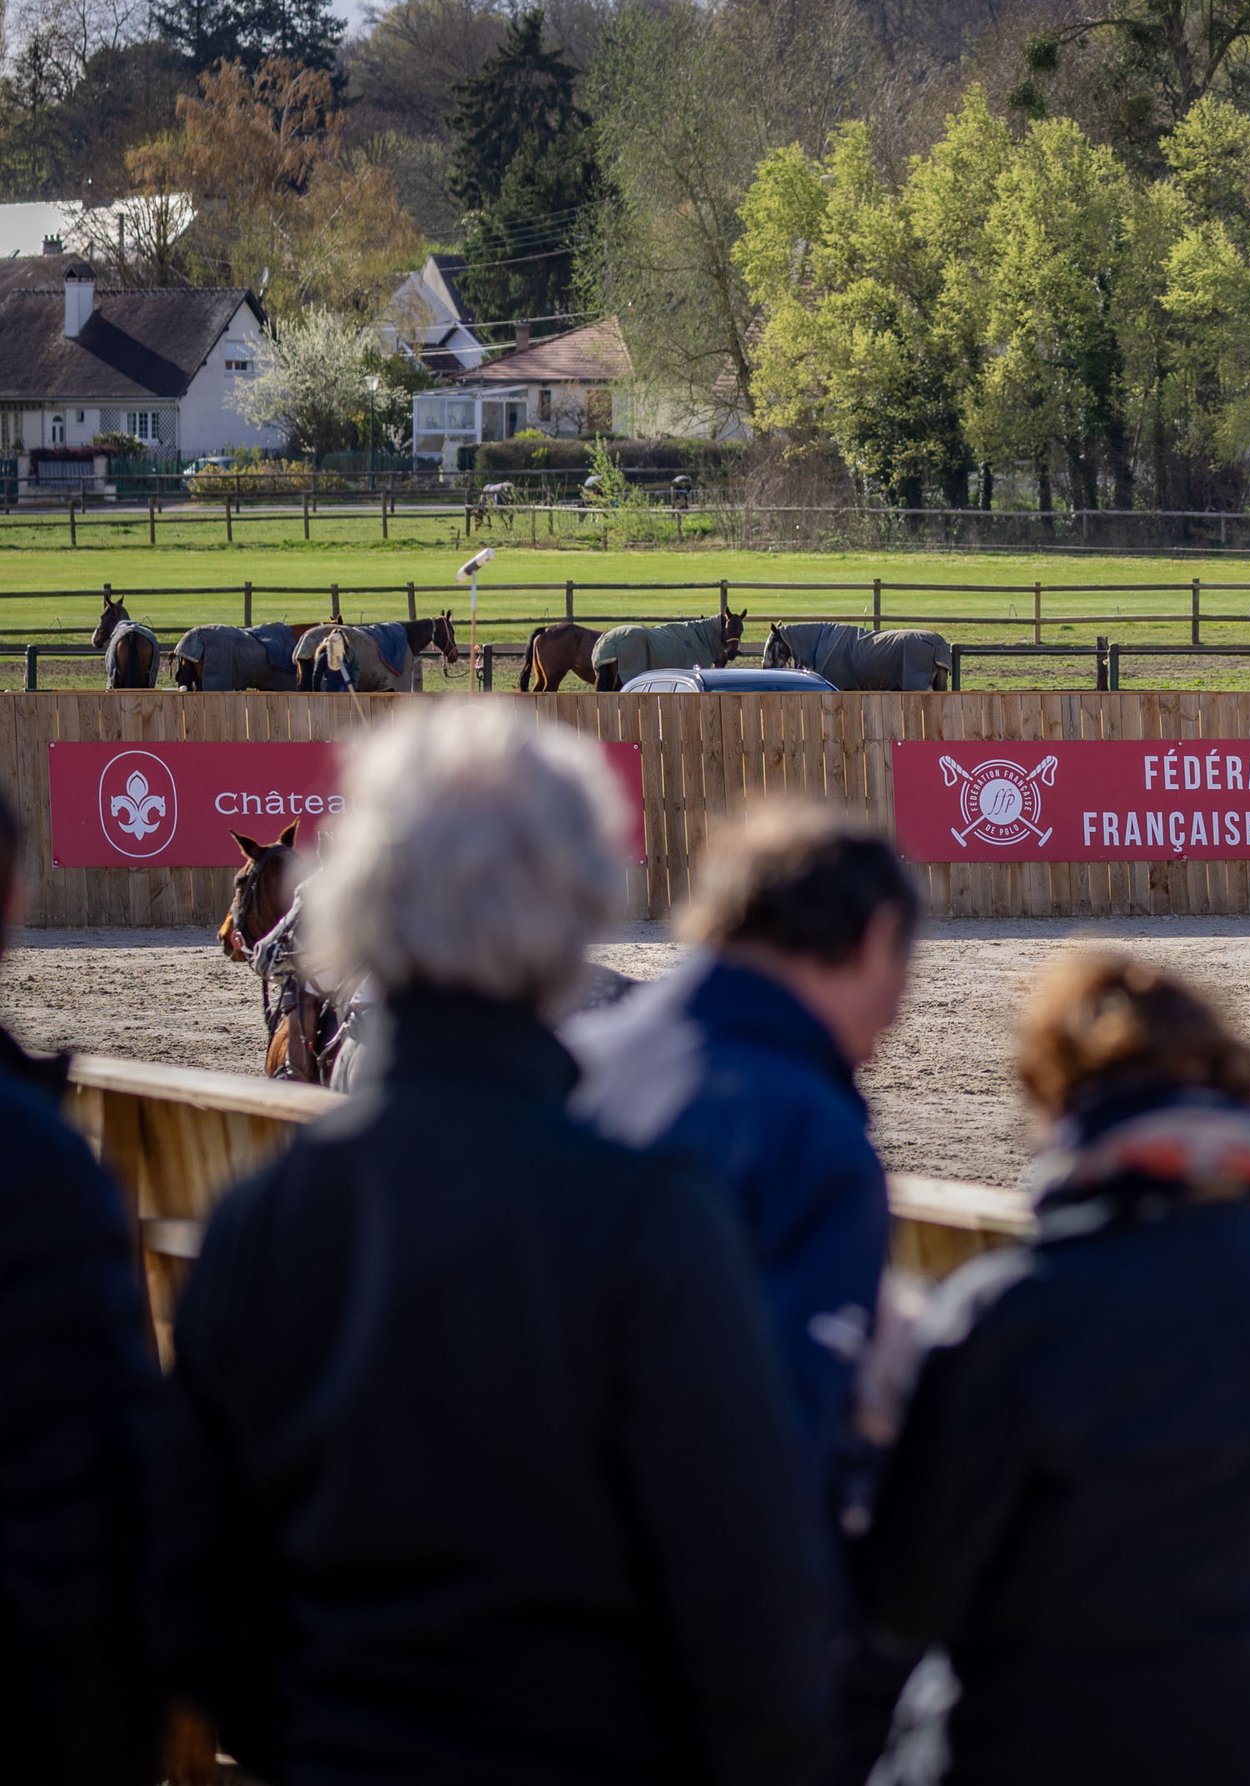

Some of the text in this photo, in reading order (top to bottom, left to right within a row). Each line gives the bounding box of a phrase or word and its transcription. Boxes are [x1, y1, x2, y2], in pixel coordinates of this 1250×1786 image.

[214, 790, 346, 816] Châtea
[969, 769, 1033, 812] FÉDÉRATION FRANÇAISE
[985, 823, 1020, 836] DE POLO
